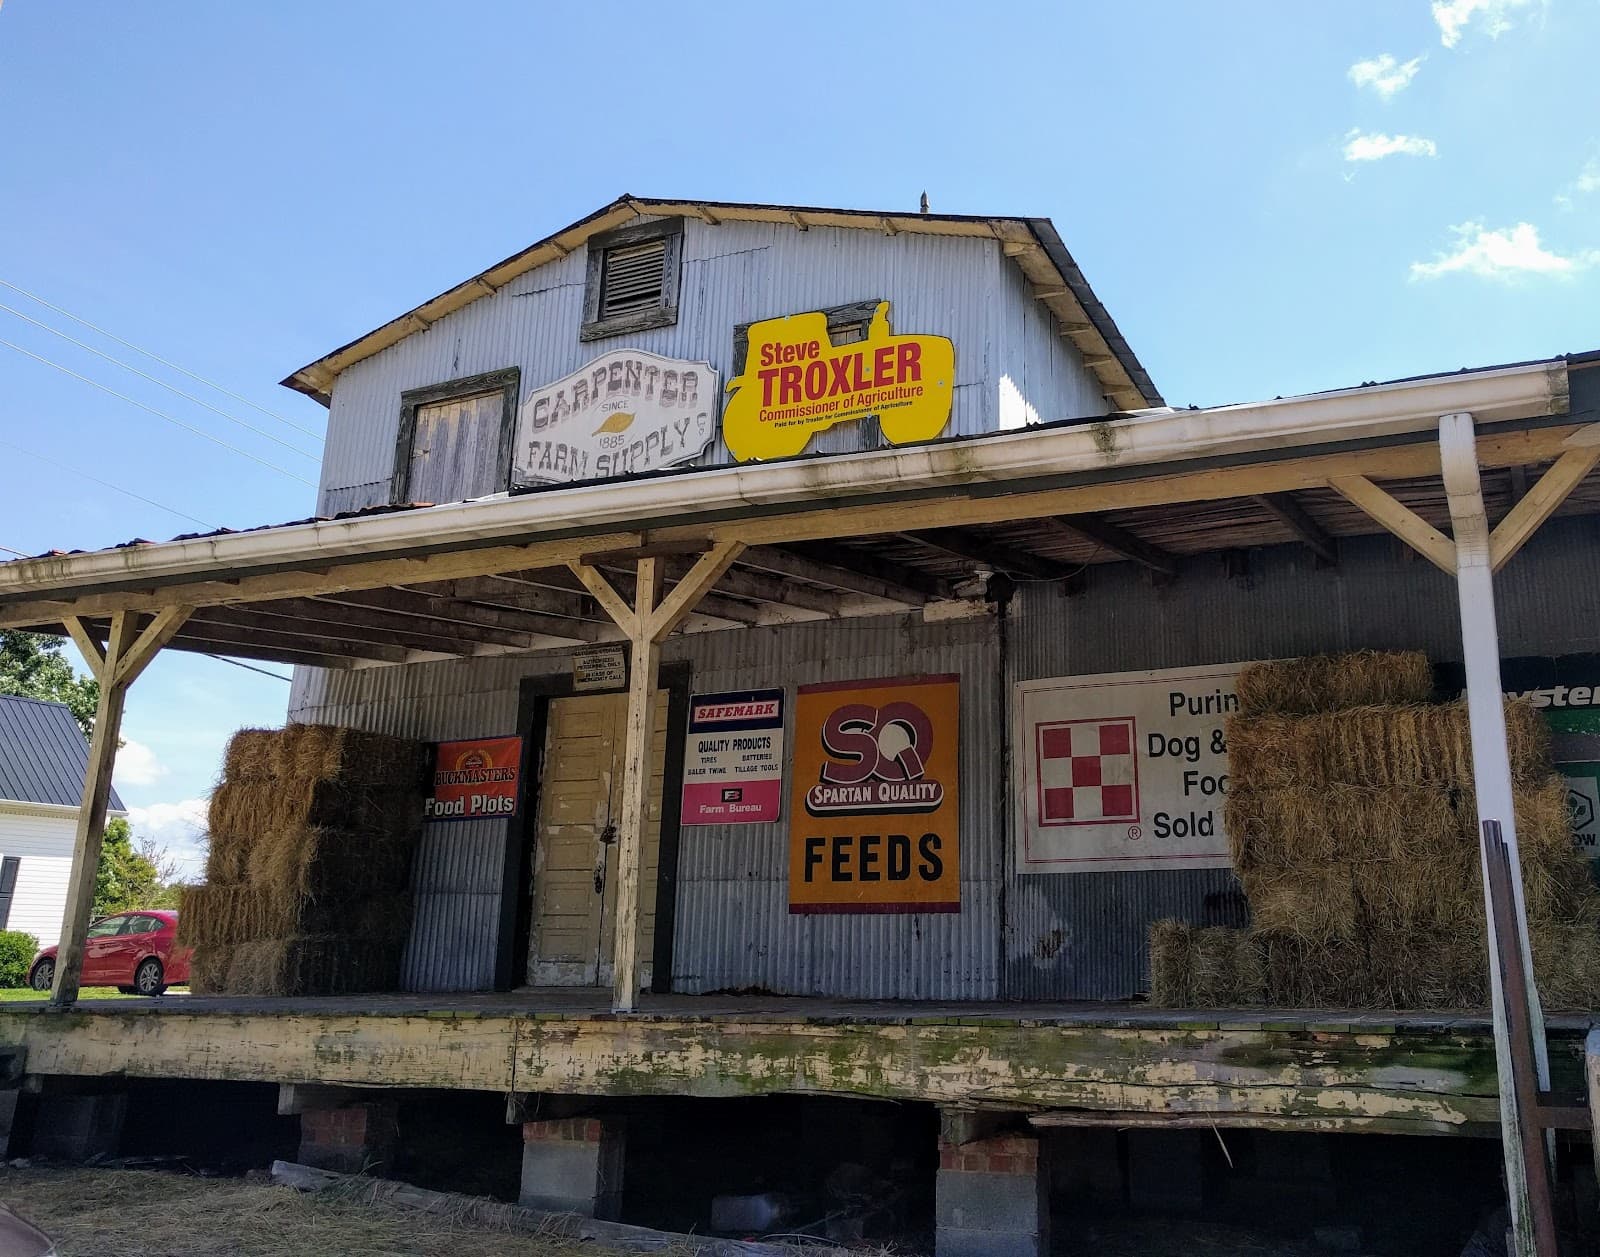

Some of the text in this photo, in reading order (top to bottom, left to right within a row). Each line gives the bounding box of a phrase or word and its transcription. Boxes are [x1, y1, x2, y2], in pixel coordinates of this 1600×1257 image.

[760, 340, 820, 367] Steve
[757, 342, 922, 407] TROXLER
[532, 359, 698, 433] CARPENTER
[601, 400, 629, 413] SINCE
[759, 385, 924, 422] Commissioner of Agriculture
[834, 407, 872, 418] Commissioner
[881, 400, 913, 410] Agriculture
[527, 441, 588, 476] FARM
[595, 416, 690, 477] SUPPLY
[599, 434, 625, 449] 1885
[697, 703, 776, 719] SAFEMARK
[1169, 688, 1240, 717] Purin
[698, 736, 771, 753] QUALITY PRODUCTS
[820, 701, 934, 784] SQ
[1148, 729, 1228, 762] Dog &
[701, 756, 717, 764] TIRES
[734, 763, 779, 773] TILLAGE TOOLS
[742, 753, 772, 762] BATTERIES
[435, 767, 516, 785] BUCKMASTERS
[688, 768, 706, 776] BALER
[814, 783, 937, 804] SPARTAN QUALITY
[1183, 770, 1230, 797] Foo
[424, 795, 514, 816] Food Plots
[699, 803, 762, 814] Farm Bureau
[1153, 811, 1214, 838] Sold
[804, 832, 943, 883] FEEDS
